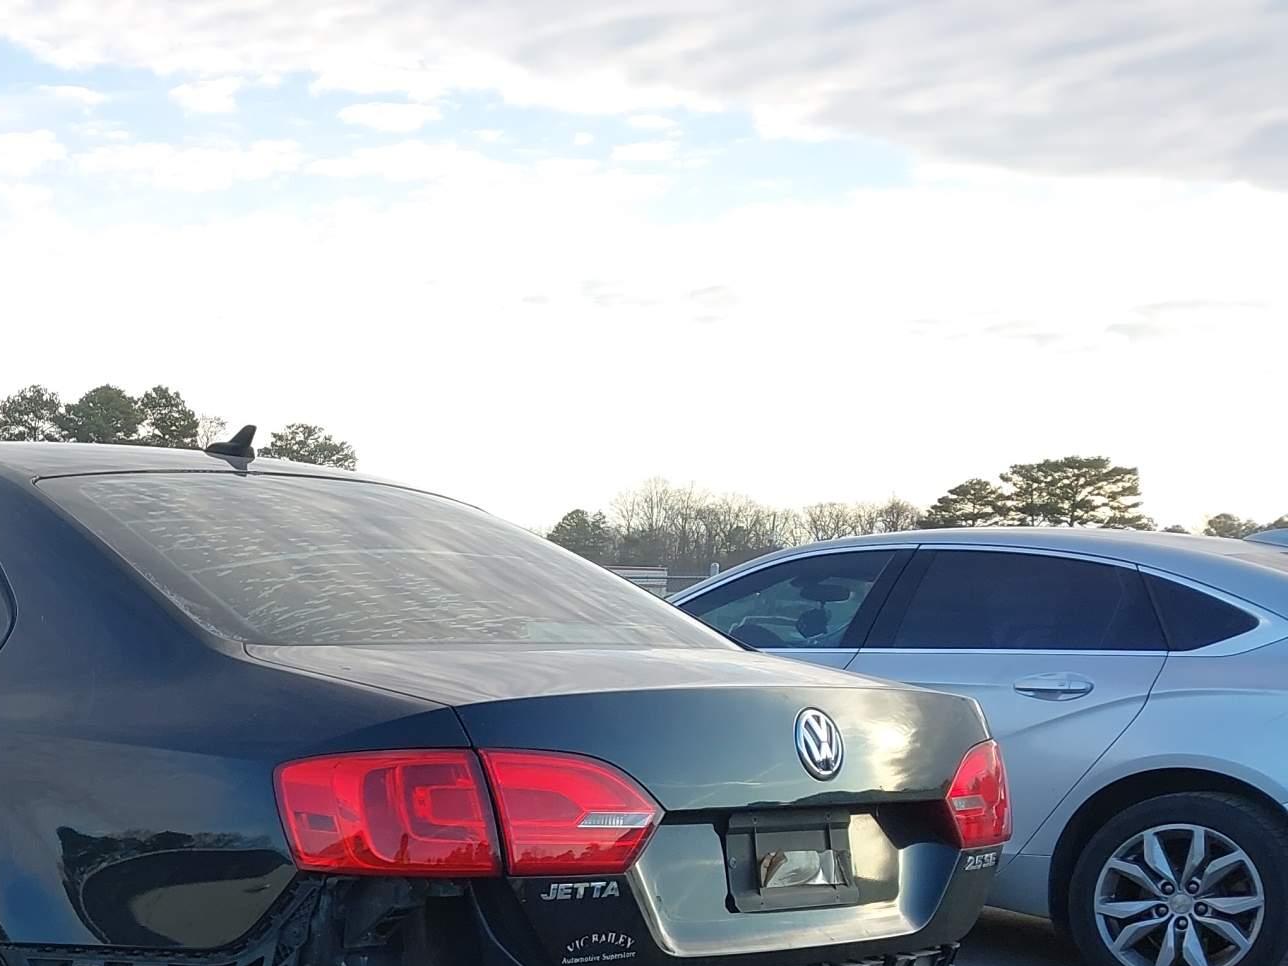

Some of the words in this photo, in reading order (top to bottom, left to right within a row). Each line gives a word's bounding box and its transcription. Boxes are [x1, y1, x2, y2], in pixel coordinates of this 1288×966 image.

[540, 881, 620, 900] JETTA
[567, 935, 589, 952] VIC
[592, 932, 635, 949] BAILEY
[561, 955, 600, 965] Automotive
[602, 951, 636, 961] Superstore
